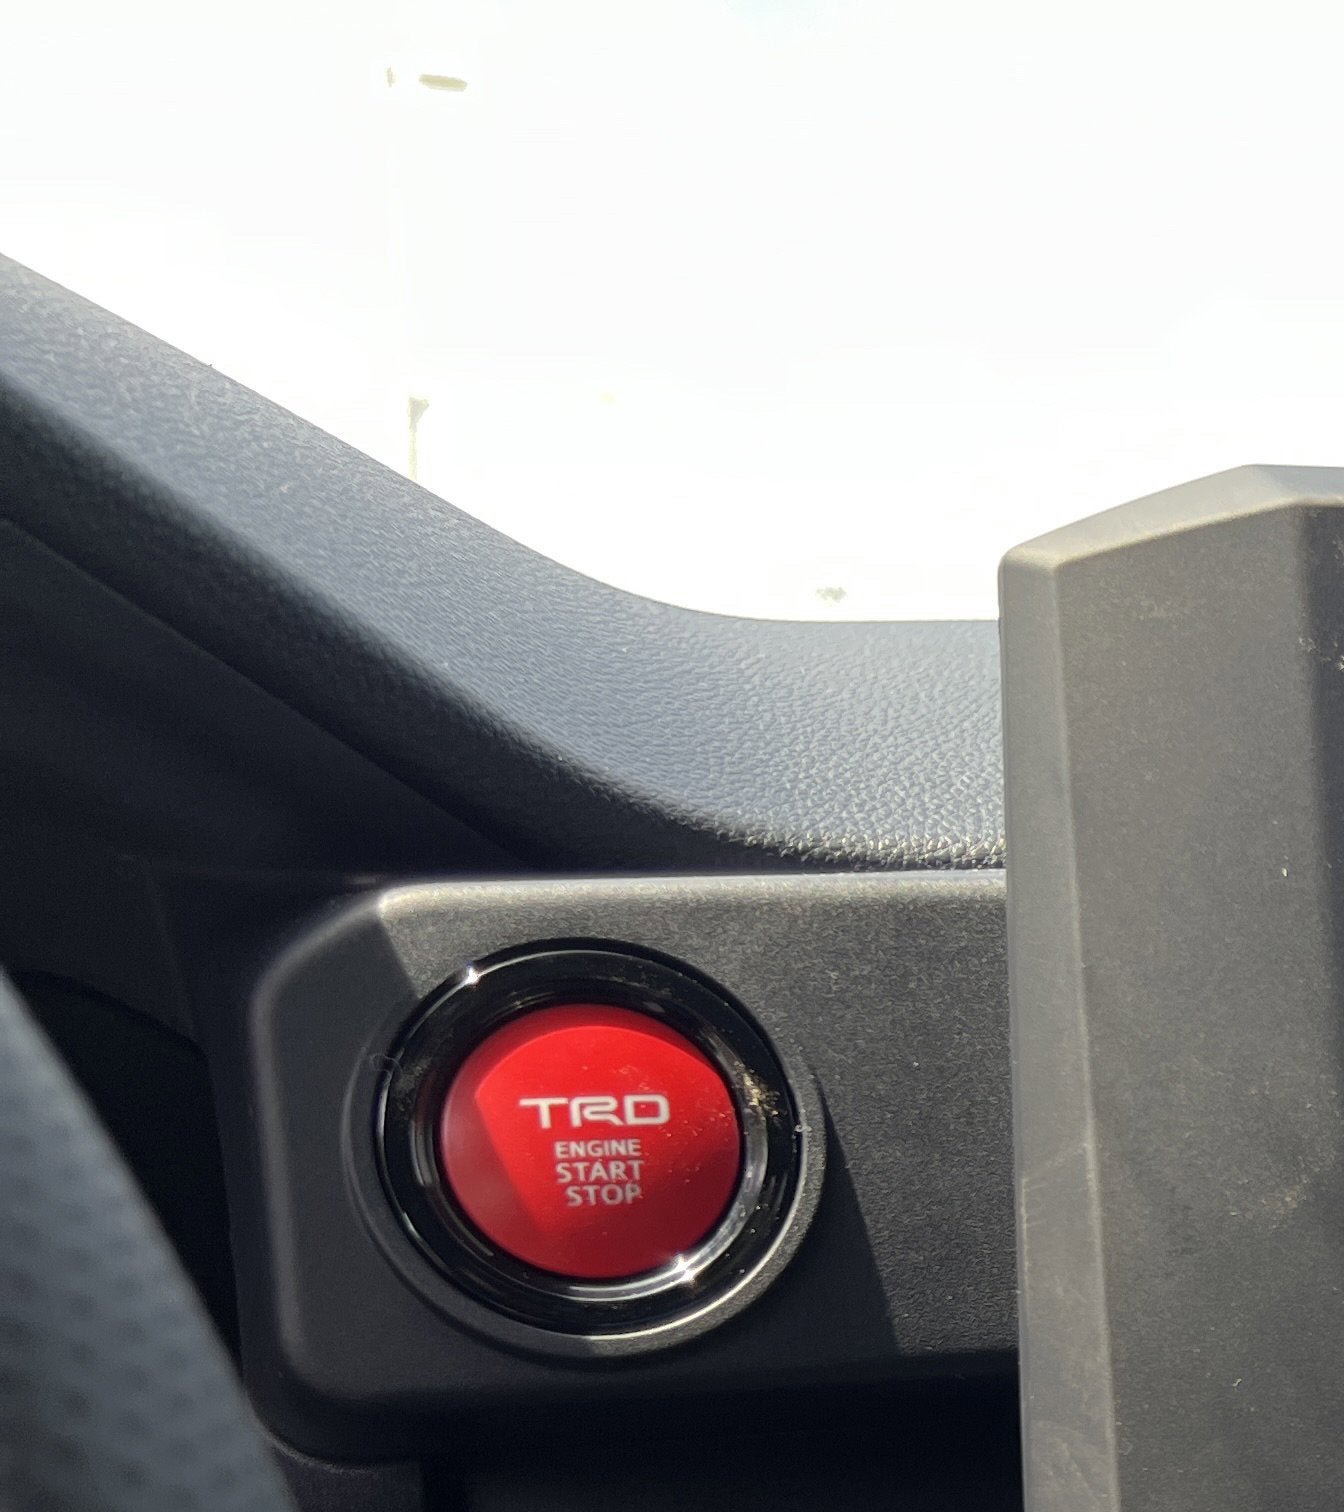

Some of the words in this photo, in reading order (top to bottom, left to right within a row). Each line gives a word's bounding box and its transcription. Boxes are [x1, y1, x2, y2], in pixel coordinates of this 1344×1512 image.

[519, 1093, 671, 1129] TRD
[554, 1138, 641, 1158] ENGINE
[556, 1160, 644, 1183] START
[565, 1183, 641, 1206] STOP
